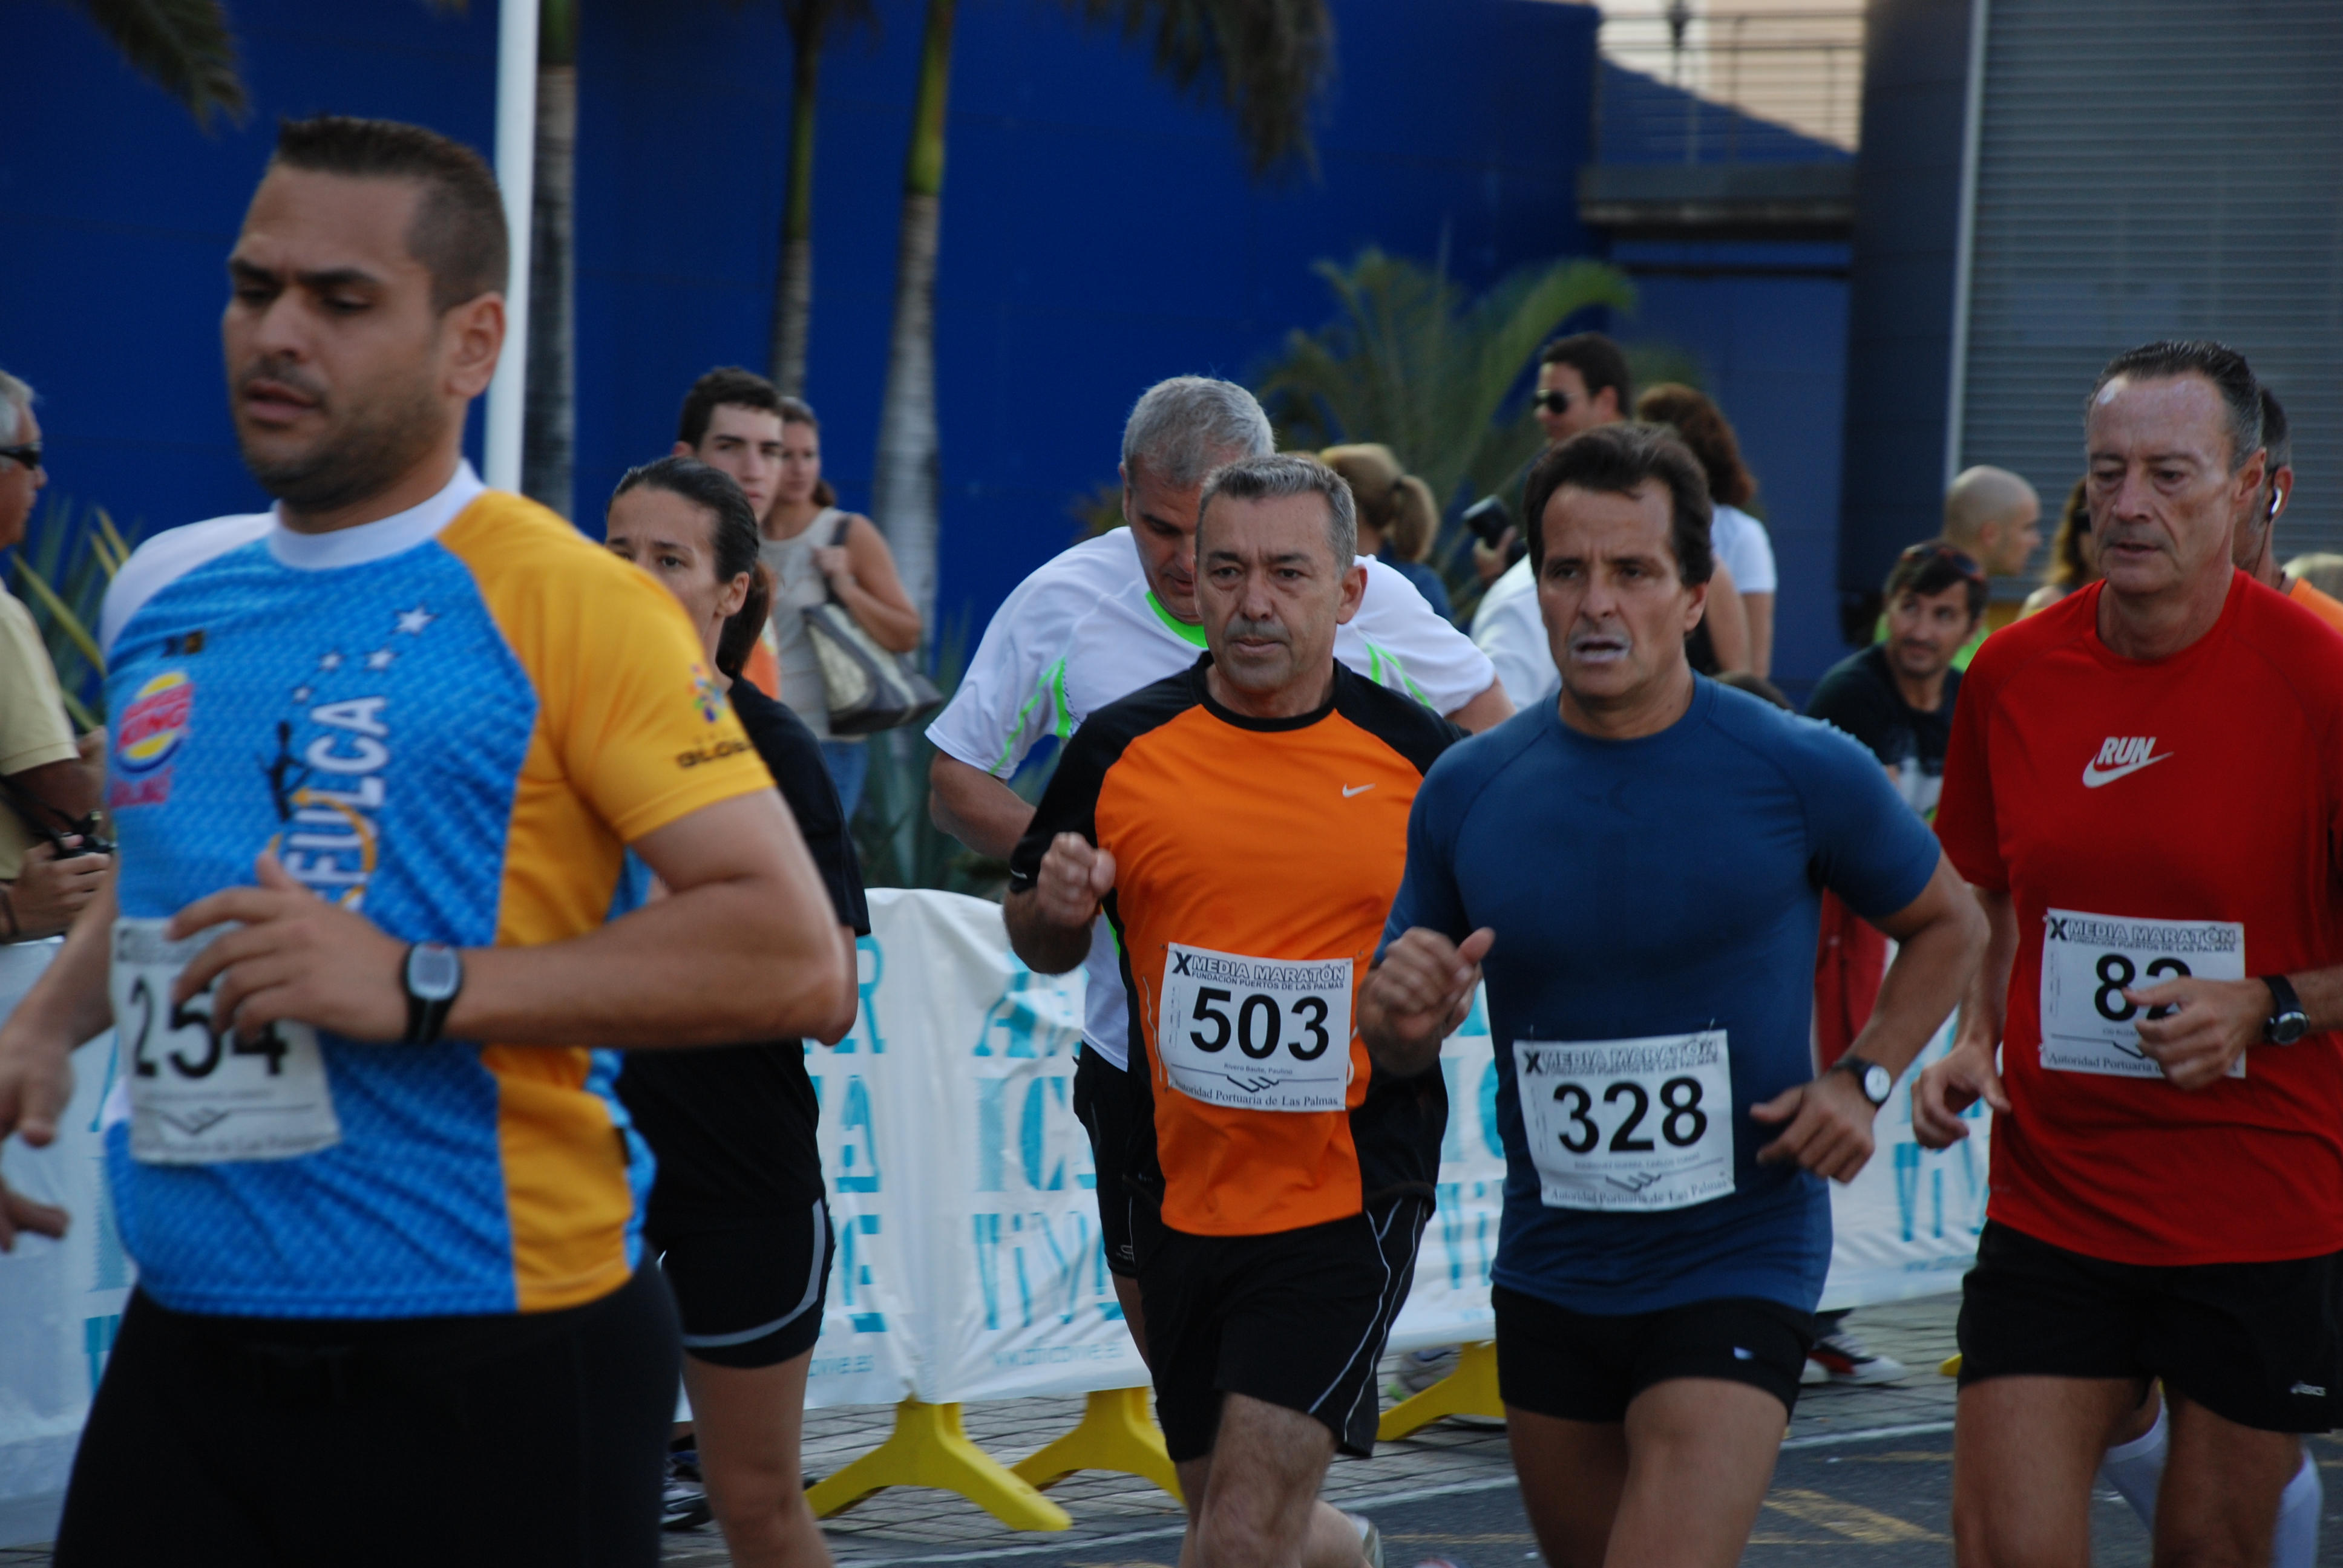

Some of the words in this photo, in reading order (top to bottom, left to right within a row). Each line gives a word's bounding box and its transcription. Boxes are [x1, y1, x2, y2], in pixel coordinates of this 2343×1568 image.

[2096, 736, 2157, 765] RUN
[2050, 918, 2068, 942] X
[2068, 919, 2129, 939] MEDIA
[2132, 926, 2236, 944] MARATÓN
[2177, 944, 2195, 953] LAS
[2197, 942, 2235, 953] PALMAS
[1172, 952, 1192, 977] X
[1192, 955, 1250, 979] MEDIA
[1254, 964, 1345, 983] MARATÓN
[1239, 979, 1279, 990] PUERTOS
[1282, 982, 1294, 990] DE
[1296, 982, 1312, 990] LAS
[1314, 980, 1345, 990] PALMAS
[1190, 986, 1329, 1061] 503
[1224, 1063, 1244, 1072] Rivero
[1524, 1050, 1542, 1075] X
[2050, 1053, 2100, 1069] Autoridad
[2103, 1057, 2152, 1073] Portuaria
[1216, 1089, 1262, 1105] Portuaria
[1265, 1095, 1277, 1106] de
[1282, 1096, 1300, 1106] Las
[1304, 1096, 1339, 1106] Palmas
[1553, 1075, 1708, 1156] 328
